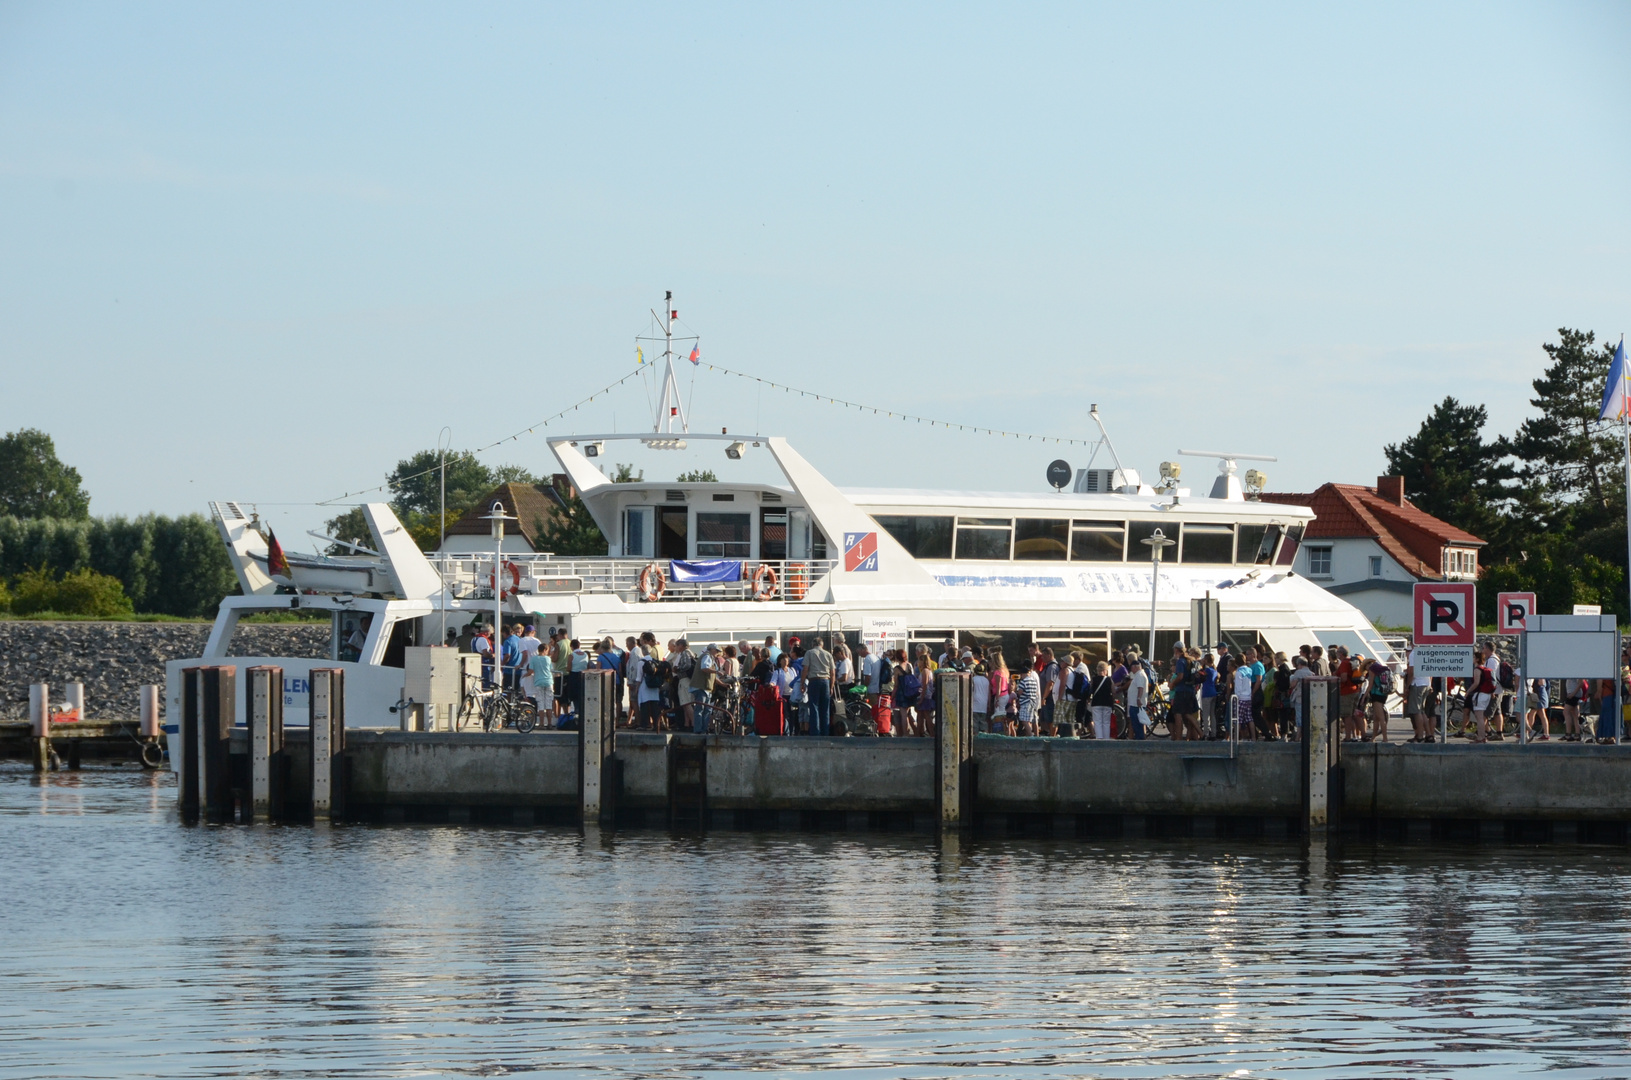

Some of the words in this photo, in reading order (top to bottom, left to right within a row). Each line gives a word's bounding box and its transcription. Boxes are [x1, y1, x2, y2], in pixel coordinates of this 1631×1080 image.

[846, 535, 855, 546] R
[866, 558, 875, 569] H
[1430, 600, 1459, 632] P
[1508, 604, 1525, 626] P
[1421, 664, 1464, 672] Fährverkehr
[284, 679, 310, 693] LEN
[284, 695, 293, 705] te
